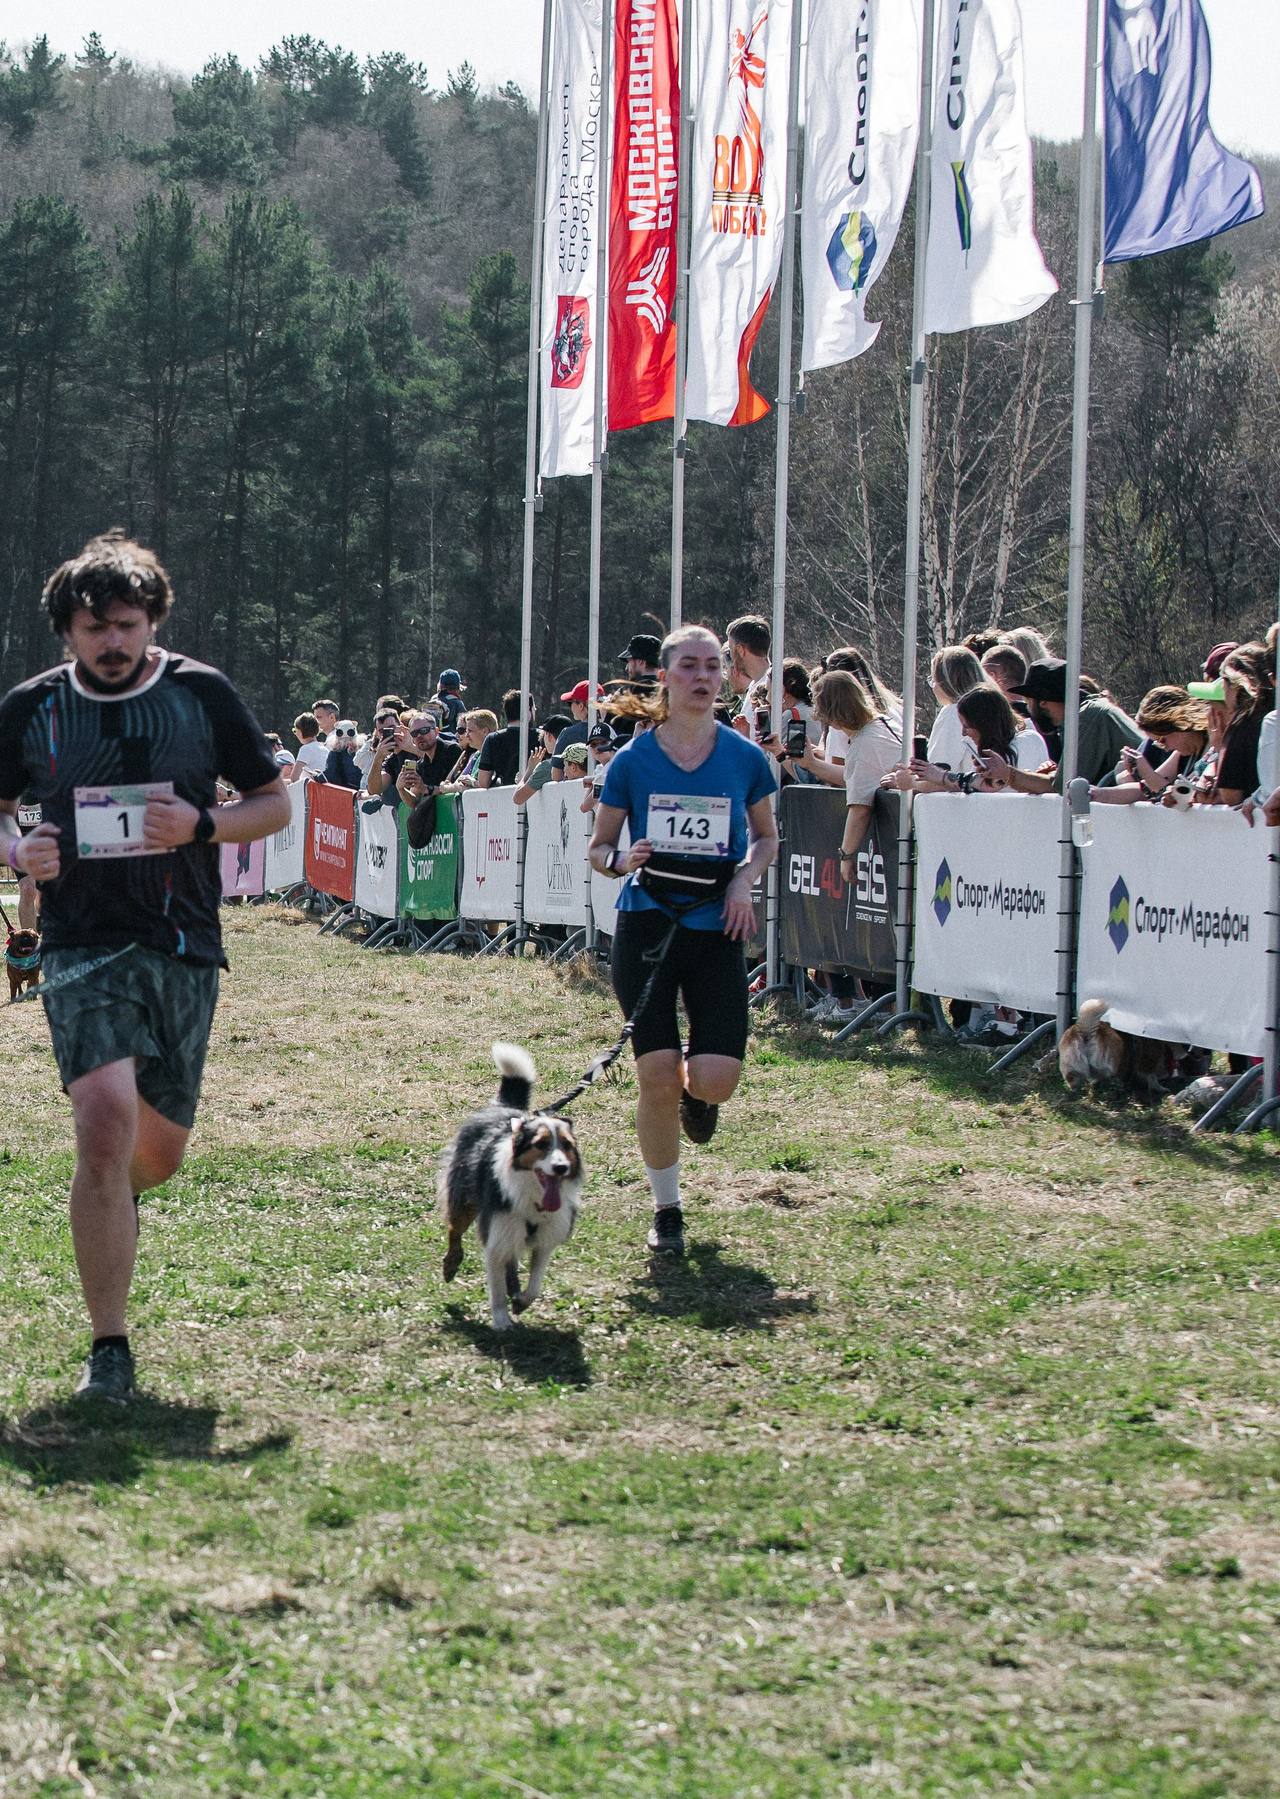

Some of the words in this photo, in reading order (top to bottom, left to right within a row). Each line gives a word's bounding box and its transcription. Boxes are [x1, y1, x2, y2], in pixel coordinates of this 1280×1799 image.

[581, 51, 601, 163] Москв
[580, 174, 594, 273] города
[24, 812, 41, 821] 173
[117, 812, 129, 838] 1
[666, 816, 710, 840] 143
[488, 838, 511, 861] mos.ru
[417, 860, 434, 880] СПОРТ
